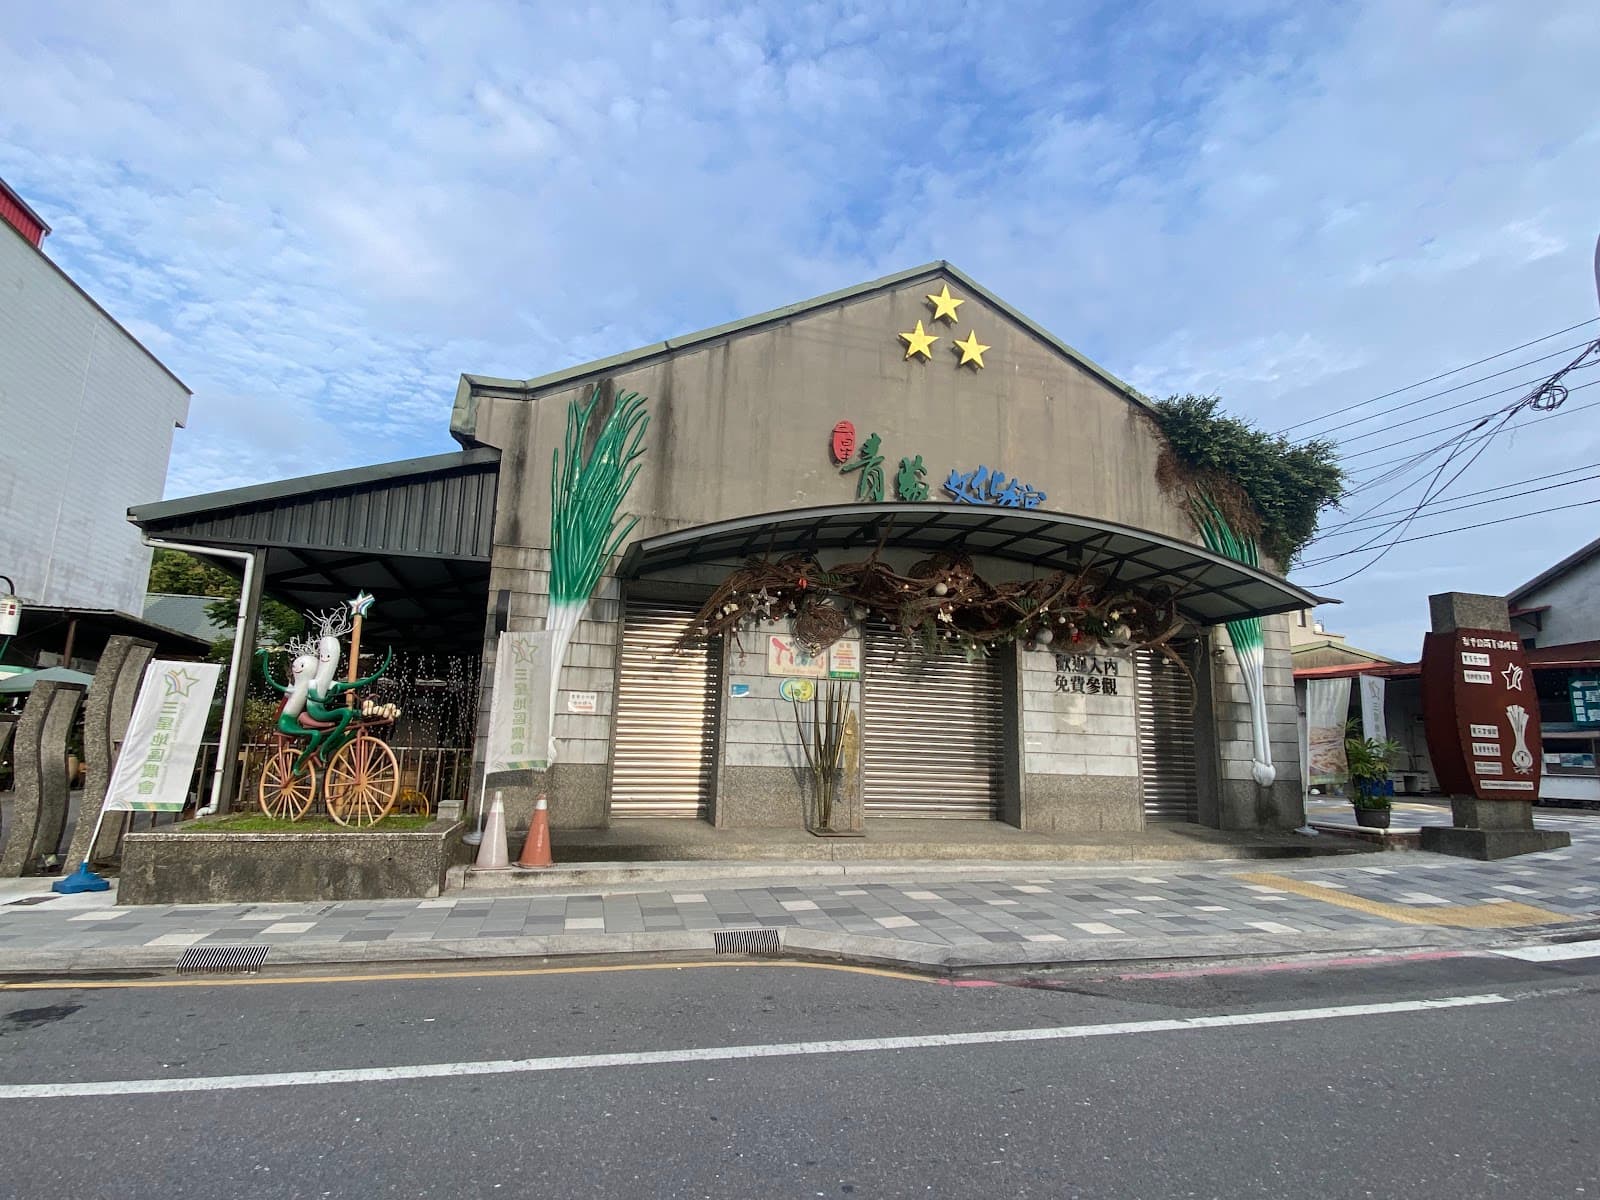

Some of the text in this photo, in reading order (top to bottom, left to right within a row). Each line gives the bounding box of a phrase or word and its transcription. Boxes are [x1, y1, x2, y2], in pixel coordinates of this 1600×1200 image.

[832, 421, 854, 461] 三星
[1055, 674, 1118, 696] 免費參觀
